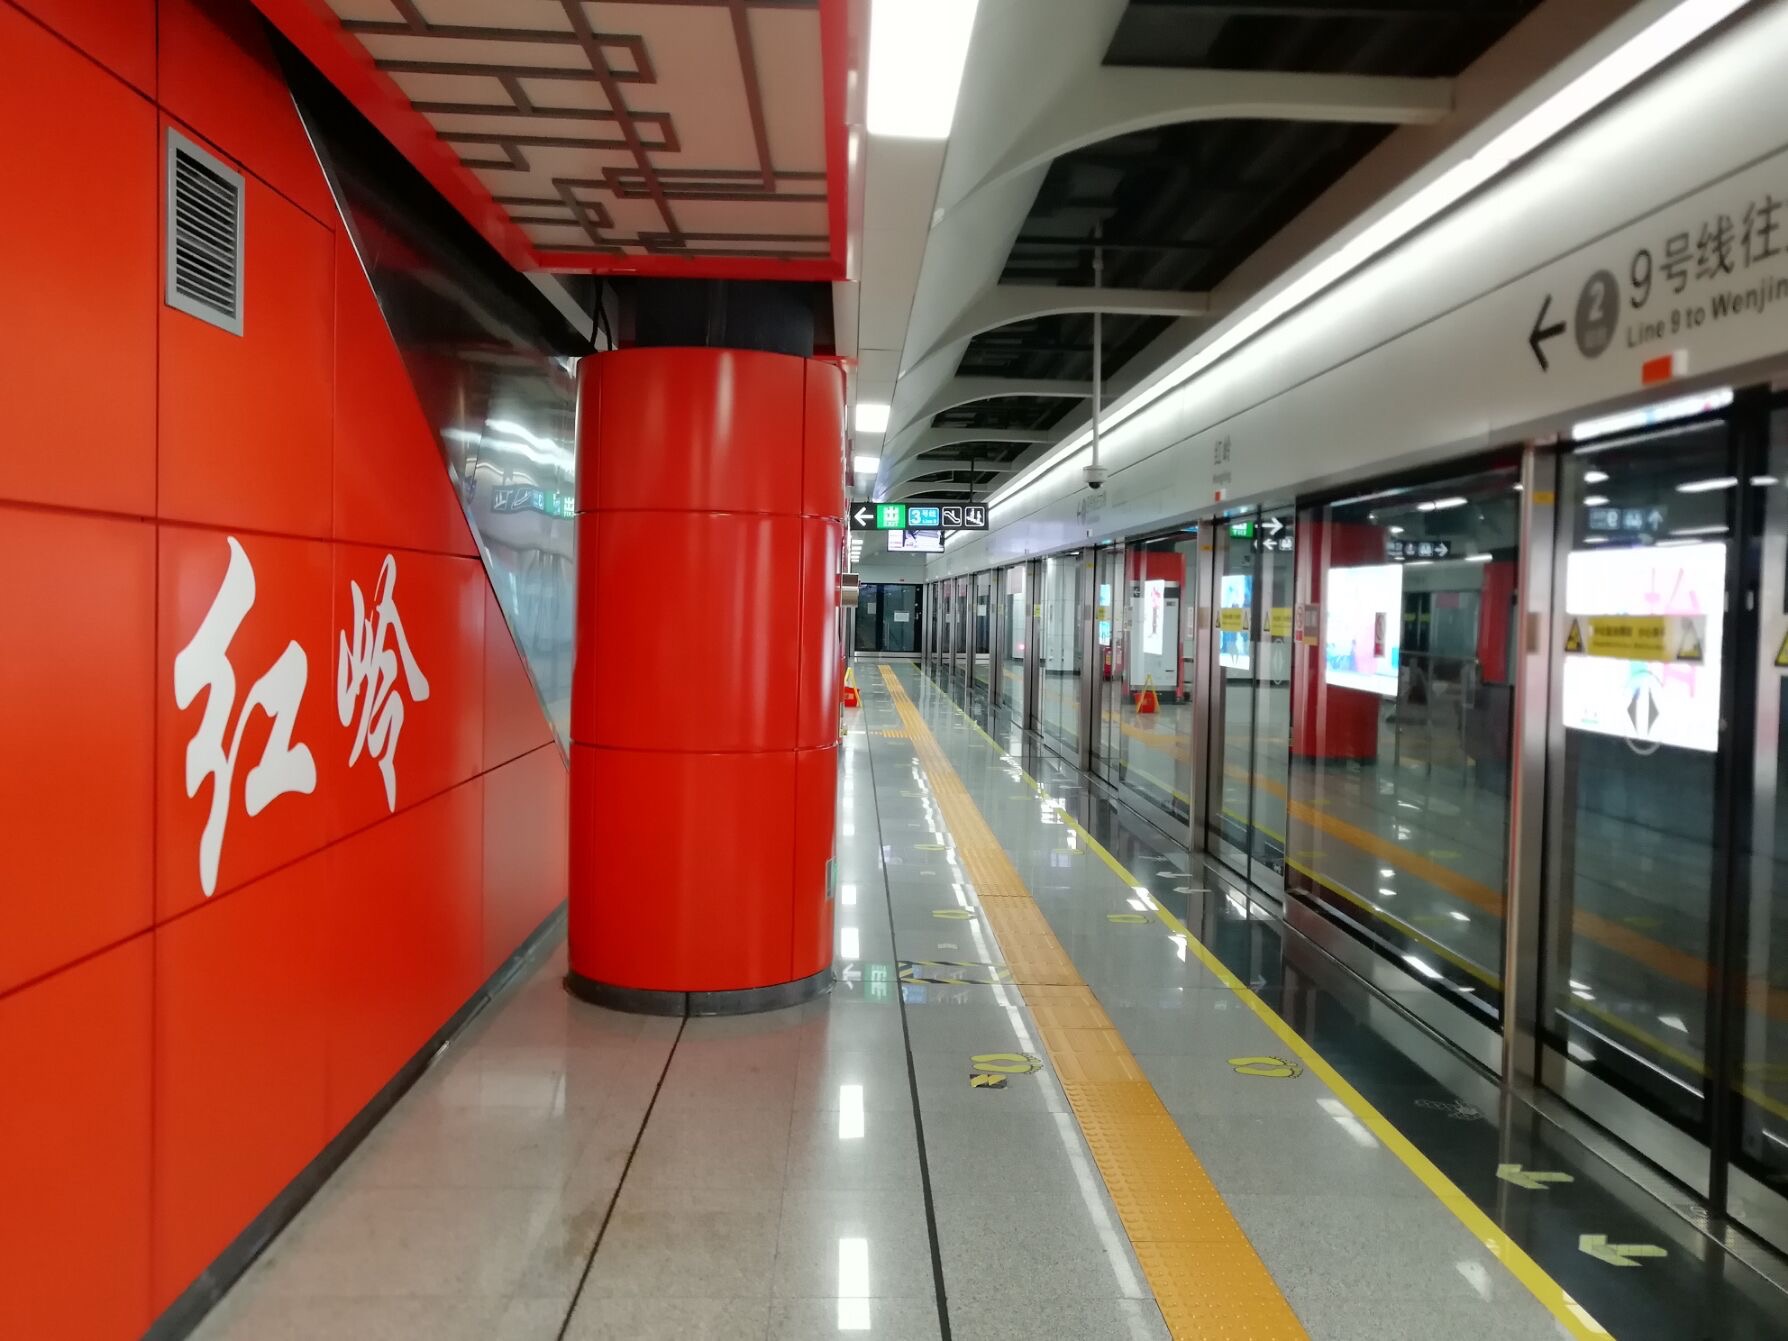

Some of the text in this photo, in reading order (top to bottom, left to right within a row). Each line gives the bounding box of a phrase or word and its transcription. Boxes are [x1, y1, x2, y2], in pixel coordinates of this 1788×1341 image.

[1630, 195, 1788, 309] 9号线往
[1627, 274, 1788, 348] Line 9 to Wenjin
[174, 536, 430, 897] 红岭
